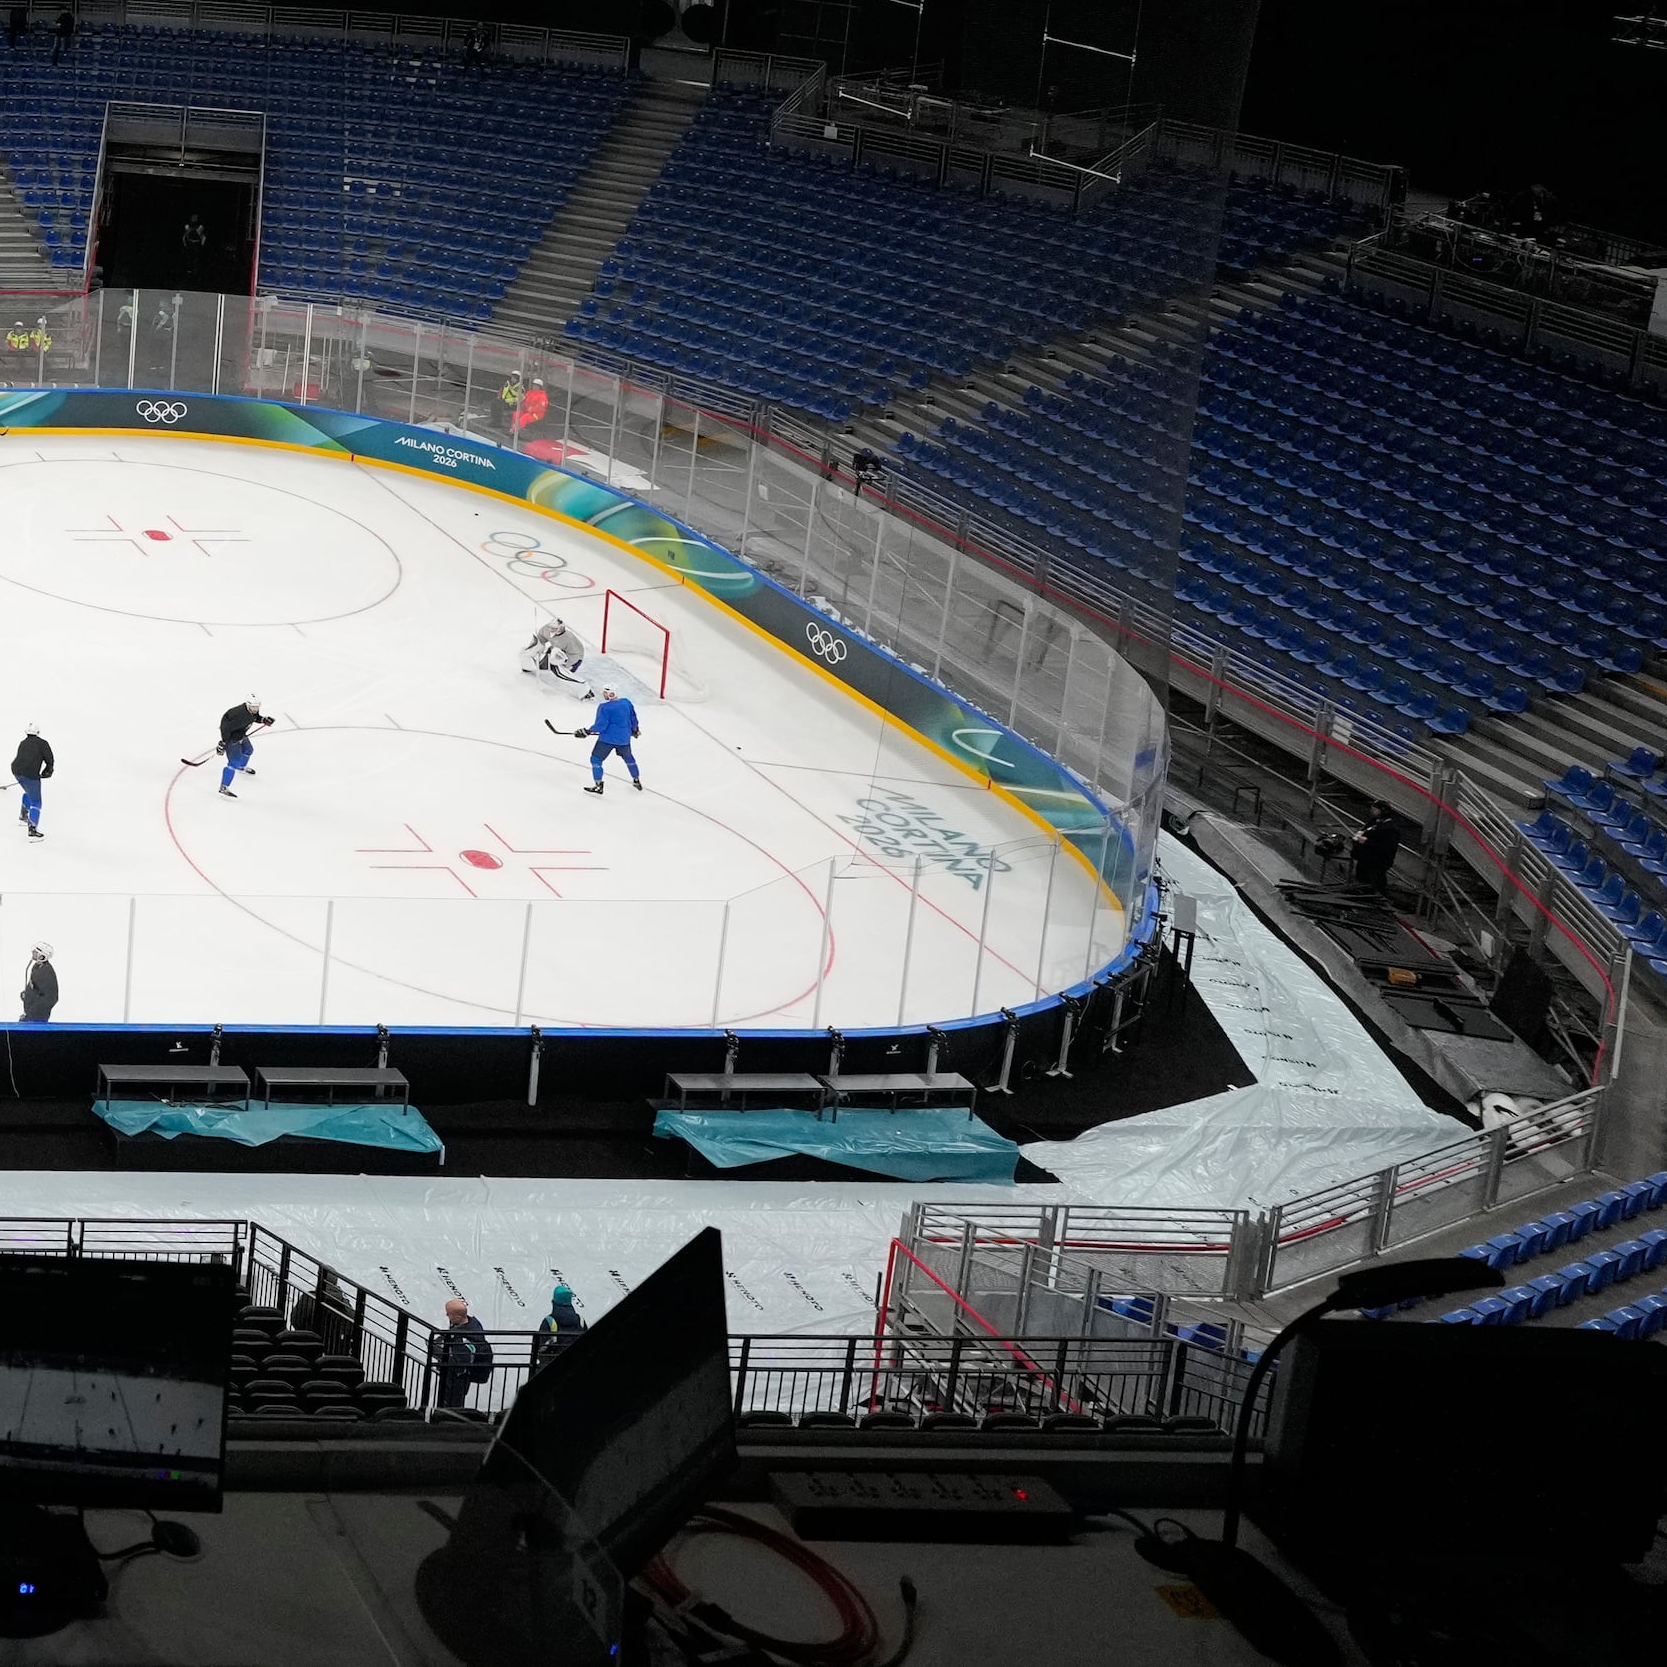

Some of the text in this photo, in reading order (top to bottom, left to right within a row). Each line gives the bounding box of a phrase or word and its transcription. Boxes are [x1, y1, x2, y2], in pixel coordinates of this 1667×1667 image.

[394, 436, 497, 471] MILANO CORTINA
[433, 453, 458, 468] 2026
[835, 814, 914, 859] 2026
[855, 798, 984, 891] CORTINA
[867, 783, 1012, 873] MILANO
